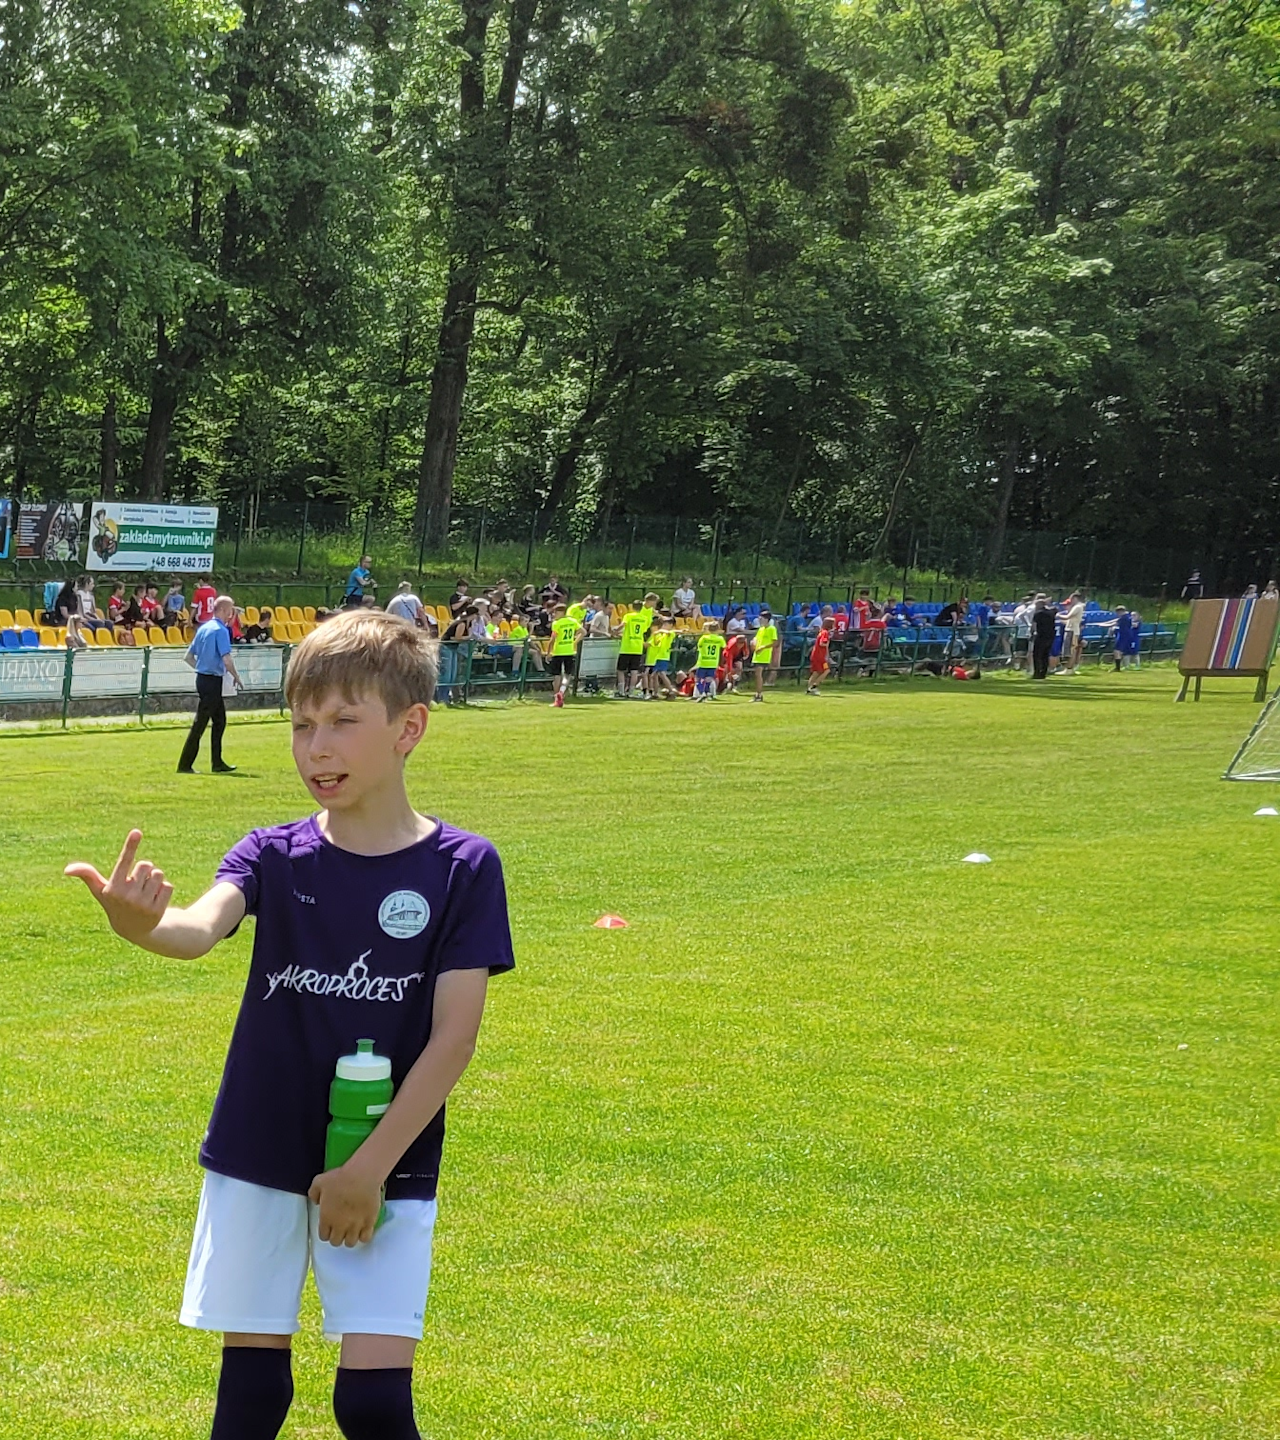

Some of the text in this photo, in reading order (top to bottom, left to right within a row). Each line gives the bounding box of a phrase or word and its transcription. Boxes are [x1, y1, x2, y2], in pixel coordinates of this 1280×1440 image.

[152, 556, 166, 566] +48
[167, 556, 180, 567] 668
[198, 557, 211, 568] 735
[707, 645, 717, 656] 18
[265, 957, 412, 1001] AKROPROCES
